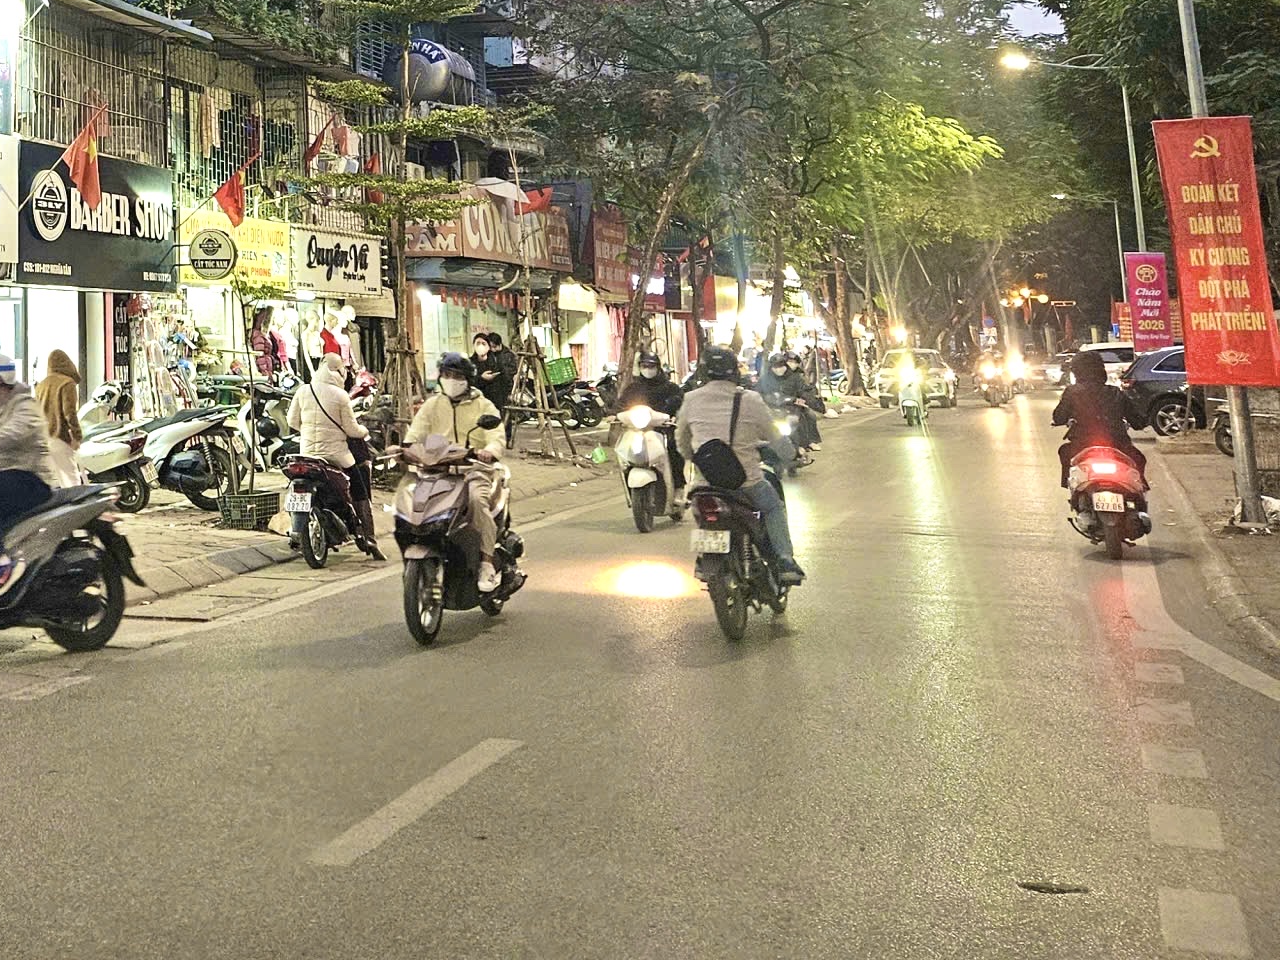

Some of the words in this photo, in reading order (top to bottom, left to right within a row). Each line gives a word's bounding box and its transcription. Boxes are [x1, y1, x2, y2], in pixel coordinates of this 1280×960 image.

[1181, 181, 1215, 204] ĐOÀN
[1218, 178, 1240, 203] KẾT
[70, 188, 131, 236] BARBER
[135, 197, 176, 241] SHOP
[1188, 213, 1214, 235] DÂN
[1216, 209, 1242, 234] CHỦ
[1190, 243, 1205, 266] KỶ
[1208, 246, 1251, 267] CƯƠNG
[1135, 286, 1162, 296] Chào
[1199, 276, 1222, 303] ĐỘT
[1224, 275, 1251, 299] PHÁ
[1137, 298, 1162, 307] Năm
[1140, 308, 1160, 317] Mới
[1138, 320, 1165, 330] 2026
[1191, 308, 1223, 331] PHÁT
[1226, 304, 1267, 331] TRIỂN!
[115, 333, 128, 353] TÓC
